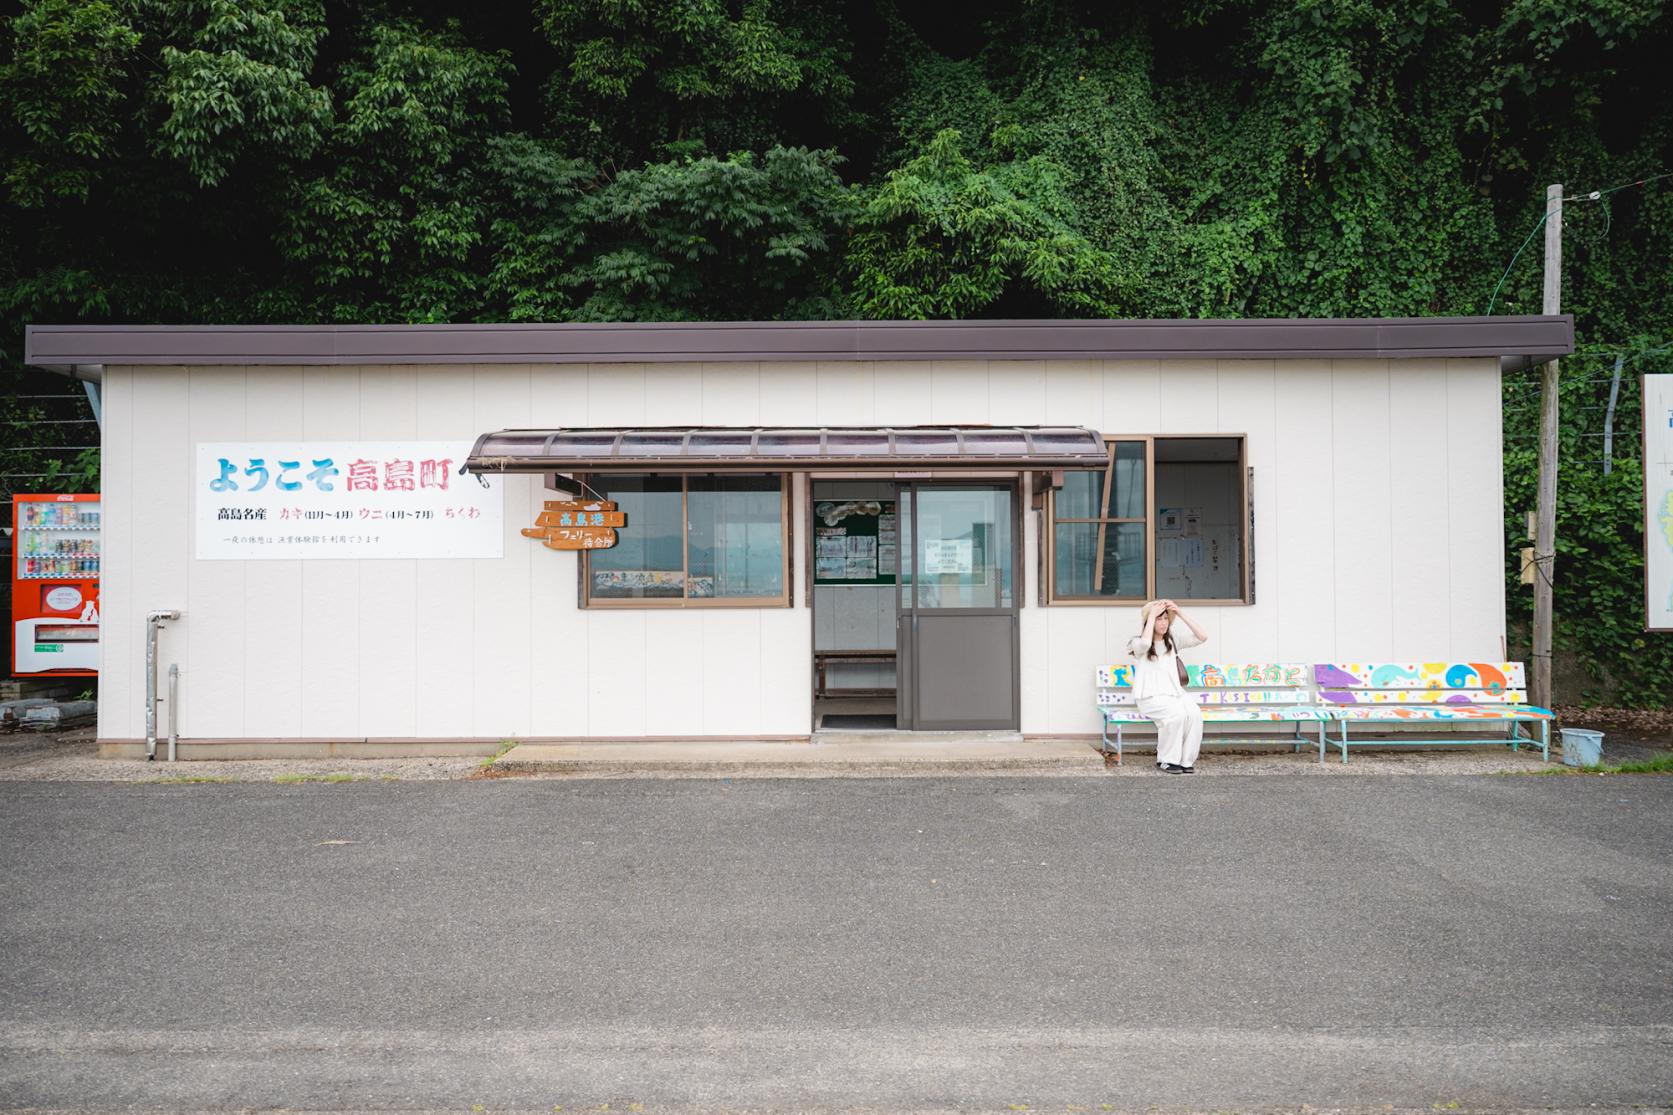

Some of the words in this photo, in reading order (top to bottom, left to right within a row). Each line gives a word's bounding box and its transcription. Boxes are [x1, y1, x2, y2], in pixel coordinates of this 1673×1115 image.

[209, 457, 453, 493] ようこそ高島町
[217, 507, 268, 521] 高島名産
[445, 506, 481, 519] ちくわ
[559, 511, 605, 527] 高島港
[582, 536, 614, 549] 待合所
